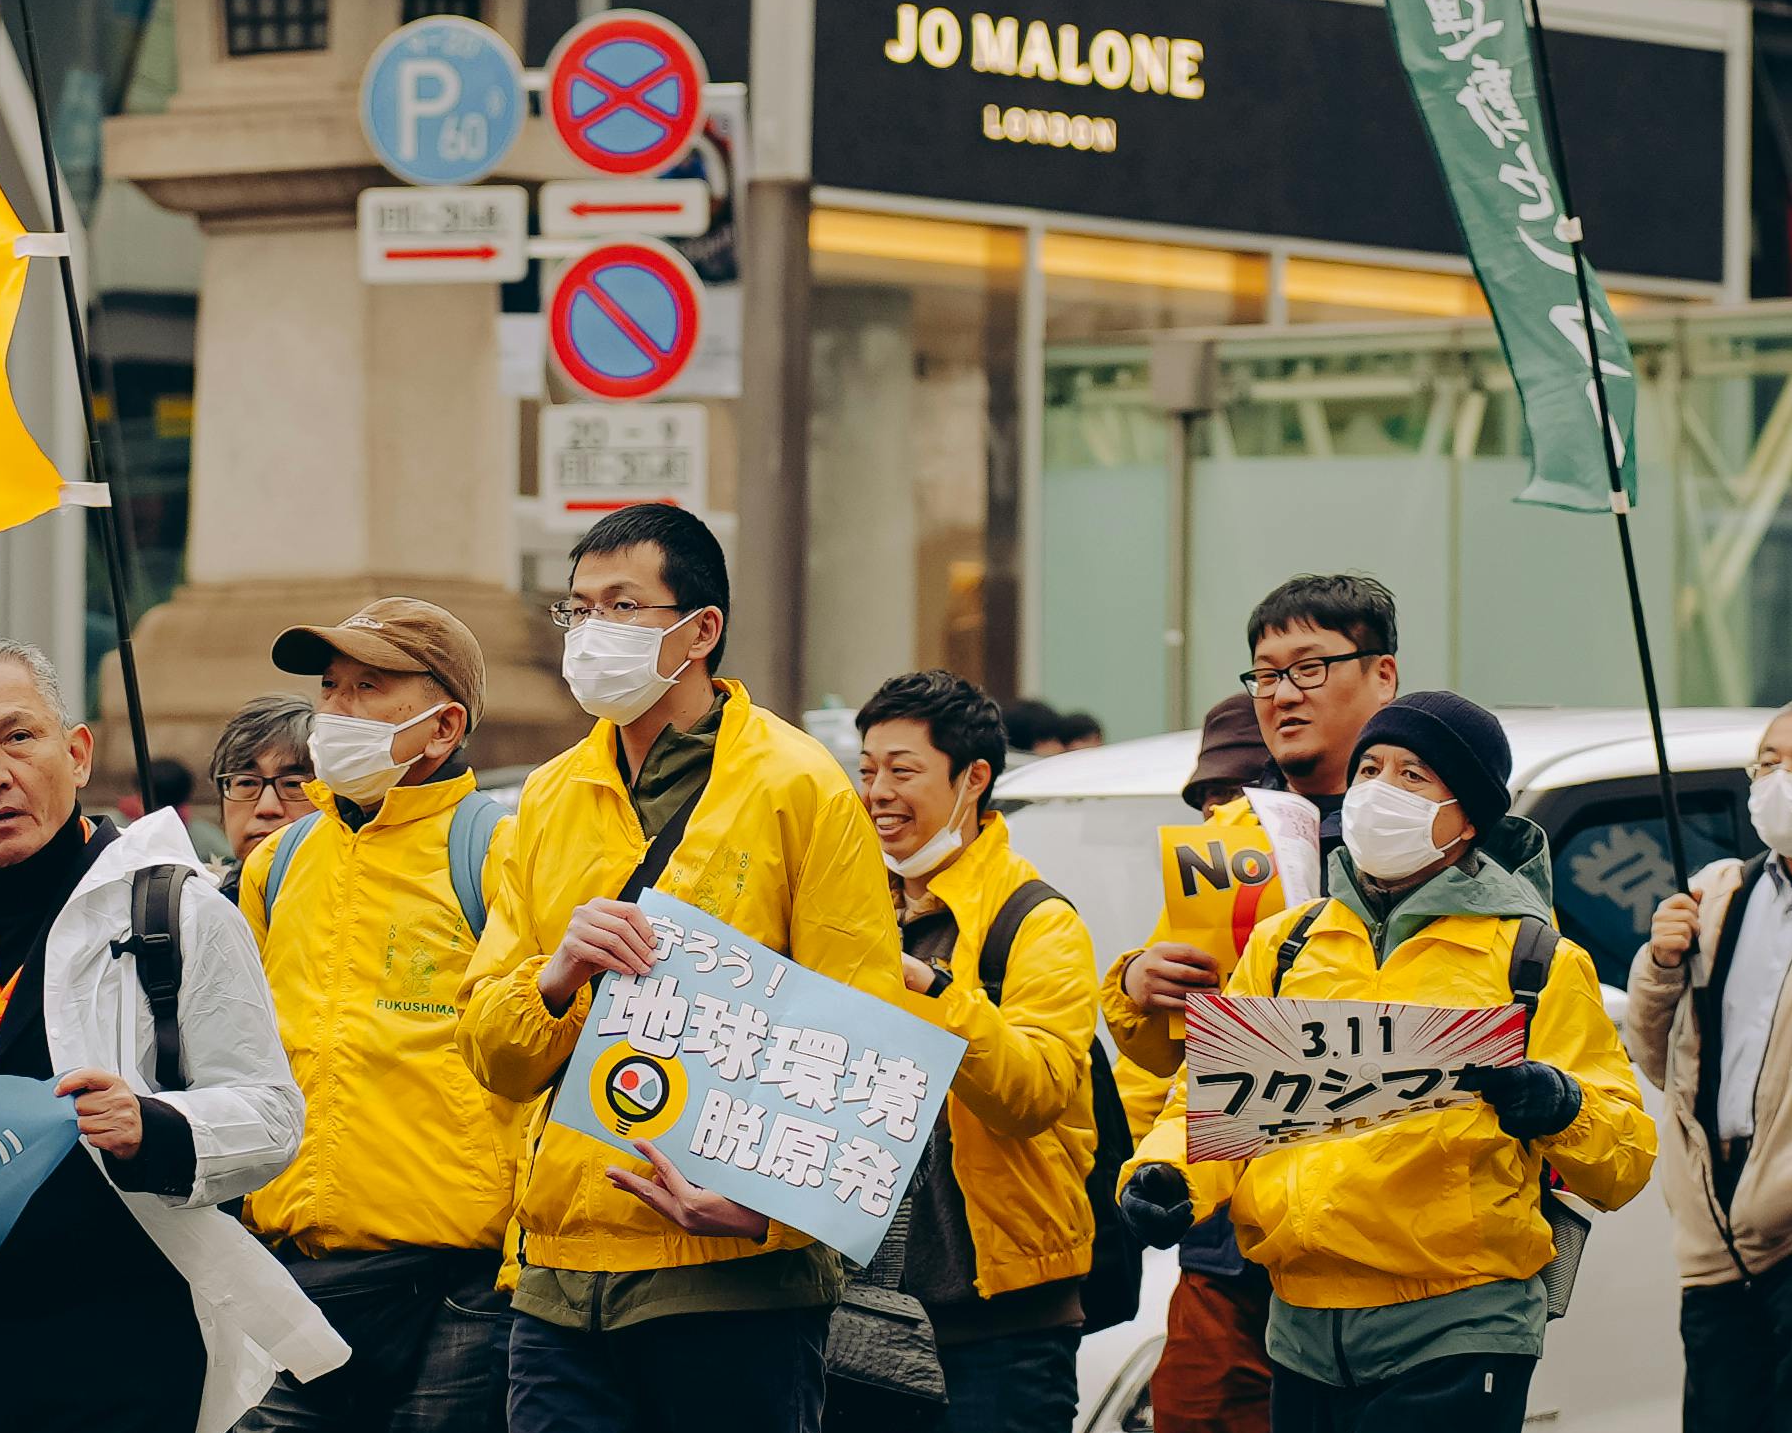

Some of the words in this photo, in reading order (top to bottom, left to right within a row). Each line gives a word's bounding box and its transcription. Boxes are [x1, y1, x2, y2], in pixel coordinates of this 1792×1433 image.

[884, 2, 962, 69] JO
[970, 12, 1205, 100] MALONE
[398, 58, 462, 162] P
[437, 111, 488, 161] 60
[982, 103, 1118, 153] LONDON
[1174, 839, 1274, 899] No
[376, 999, 457, 1015] FUKUSHIMA
[1301, 1015, 1395, 1059] 3.11
[598, 972, 928, 1143] 地球環境
[690, 1088, 902, 1219] 脱原発
